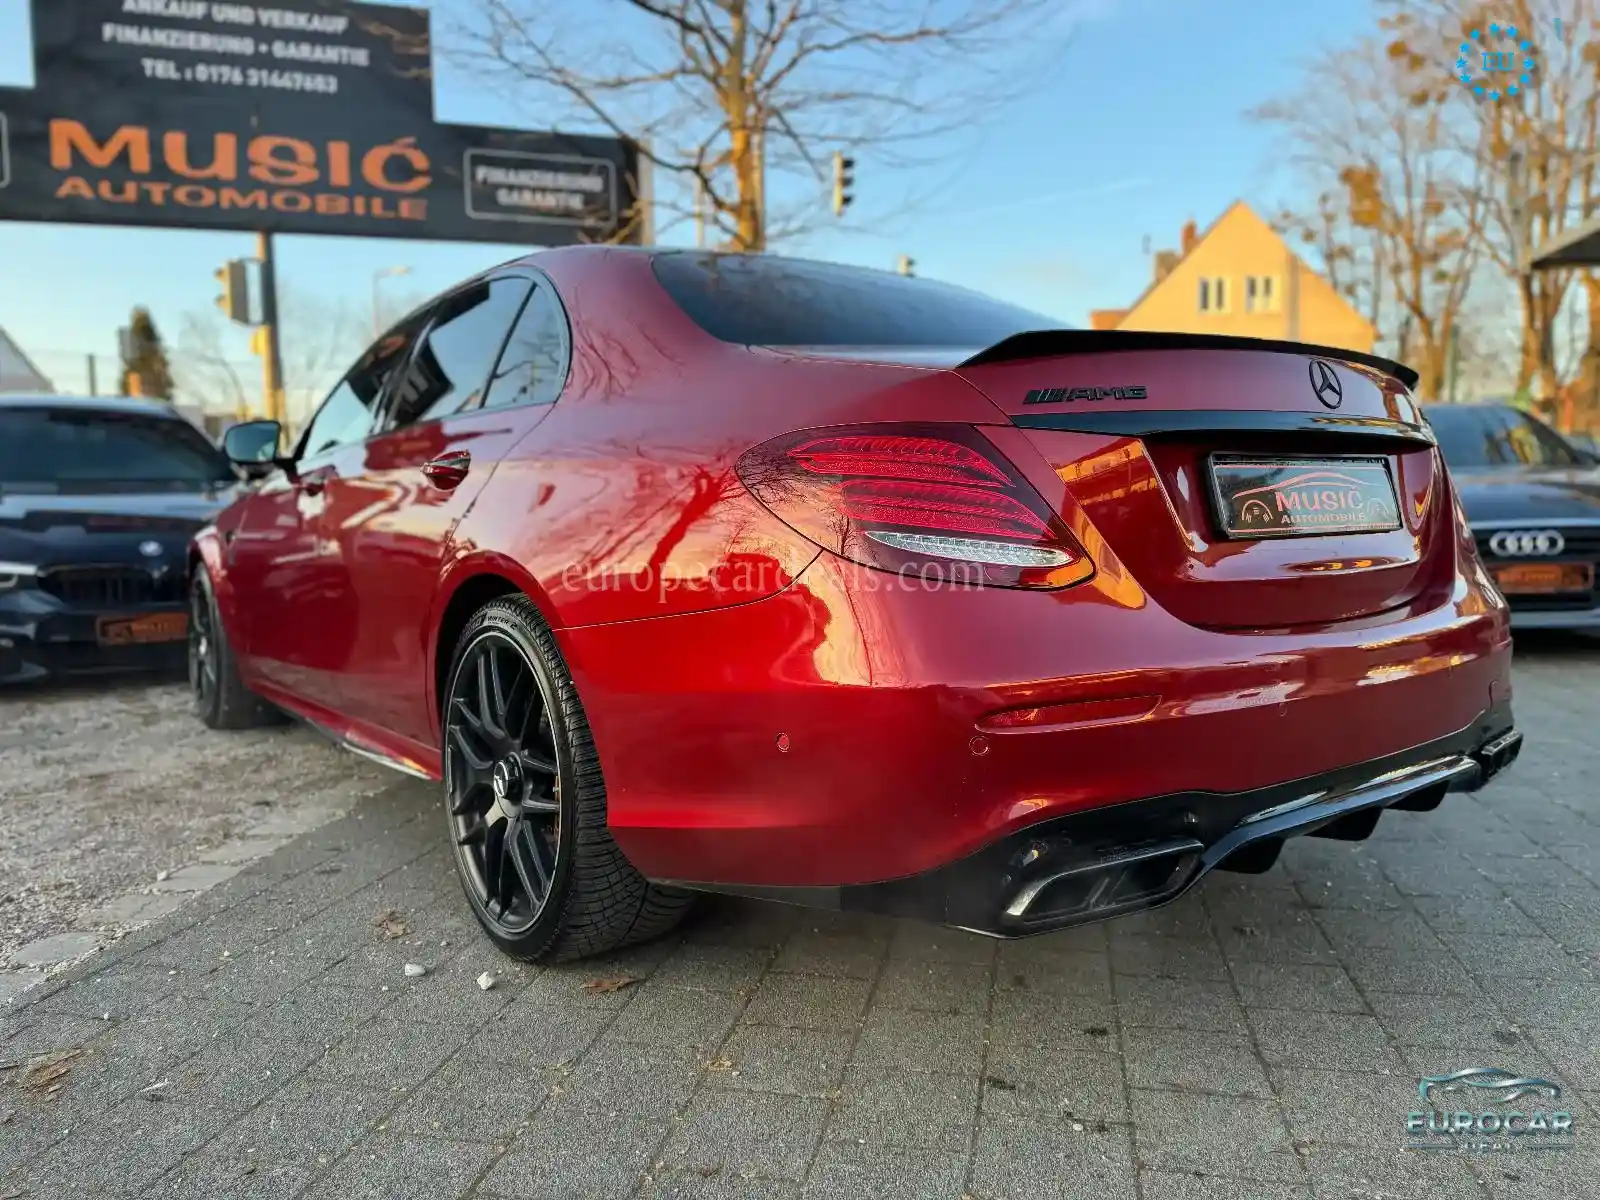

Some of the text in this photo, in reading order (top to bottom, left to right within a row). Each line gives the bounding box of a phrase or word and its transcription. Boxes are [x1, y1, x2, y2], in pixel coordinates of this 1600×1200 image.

[122, 0, 350, 35] ANKAUF UND VERKAUF
[102, 21, 370, 67] FINANZIERUNG GARANTIE
[194, 62, 244, 86] 0176
[48, 116, 434, 194] MUSIĆ
[54, 175, 428, 221] AUTOMOBILE
[1067, 386, 1148, 402] AMG
[1280, 511, 1366, 524] AUTOMOBILE
